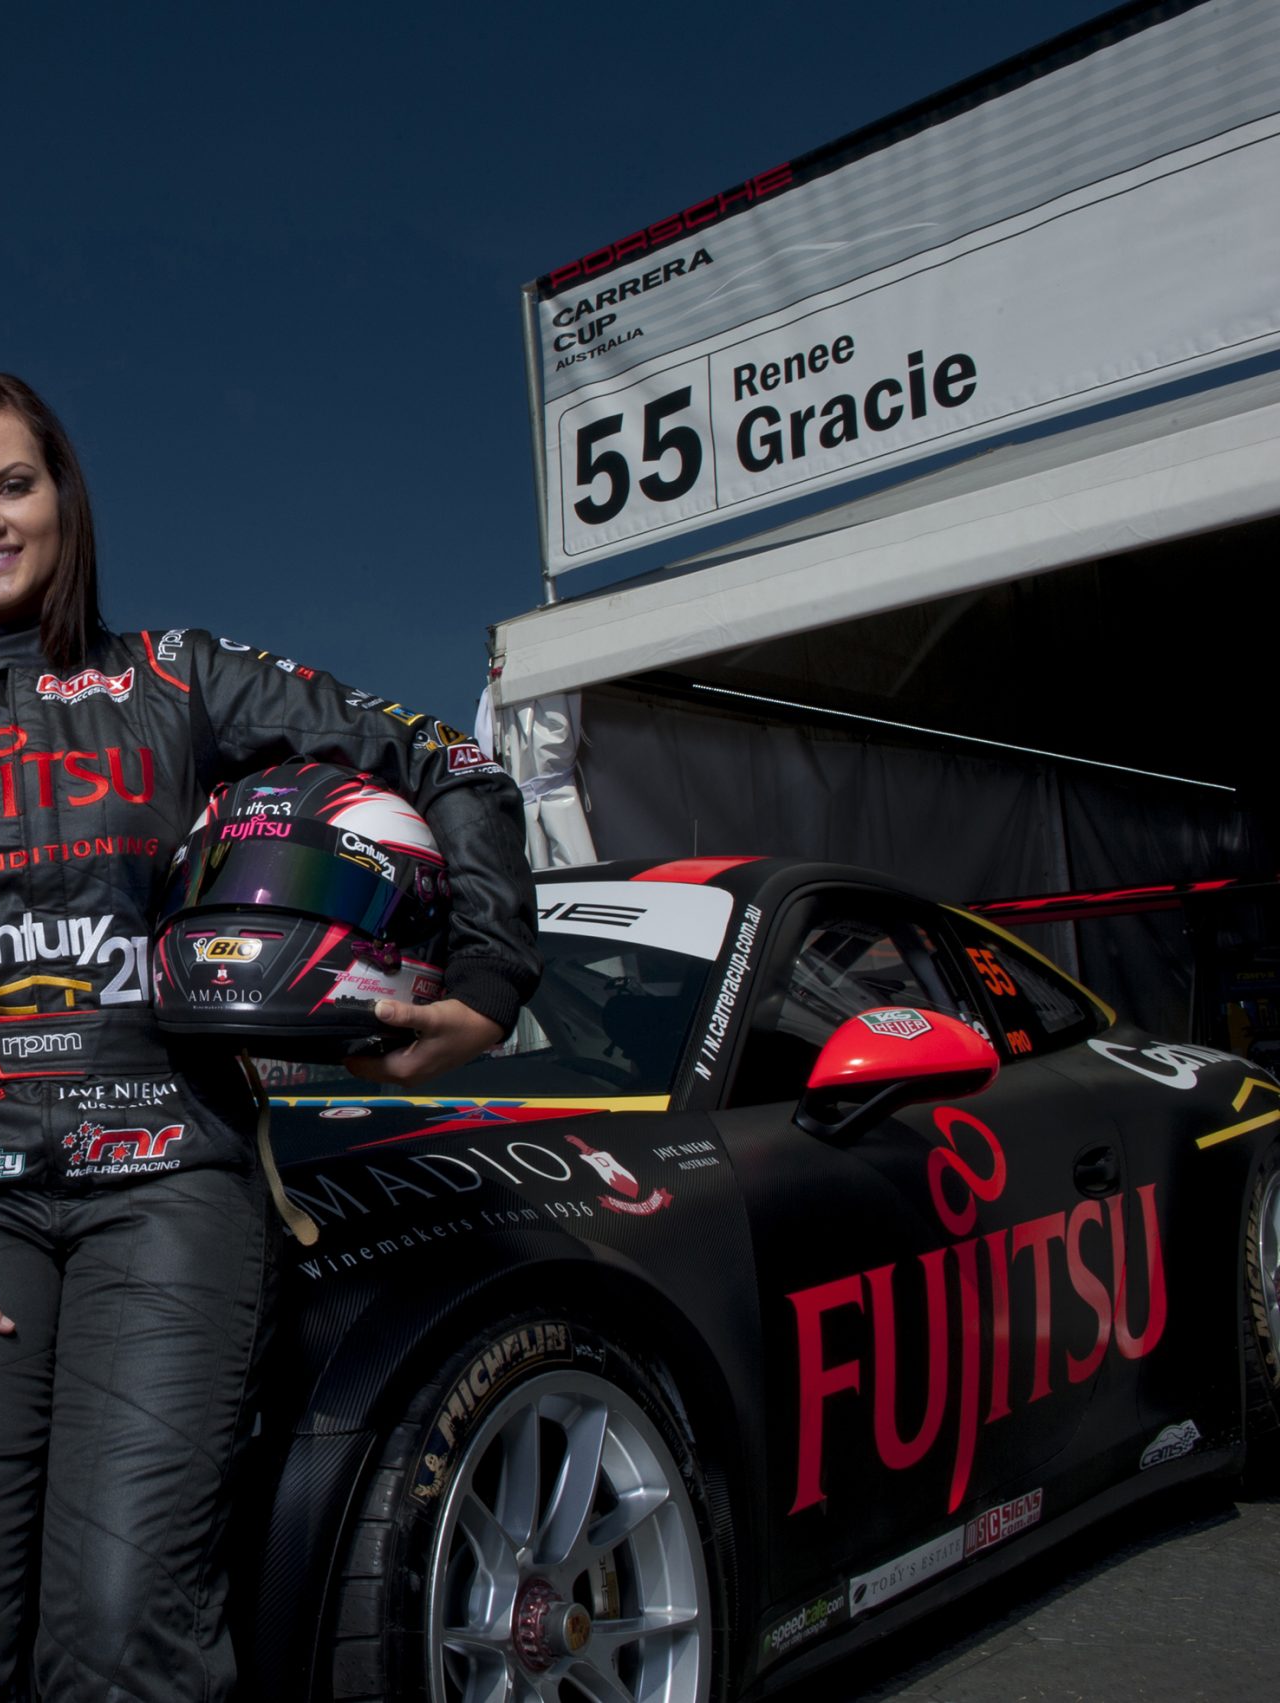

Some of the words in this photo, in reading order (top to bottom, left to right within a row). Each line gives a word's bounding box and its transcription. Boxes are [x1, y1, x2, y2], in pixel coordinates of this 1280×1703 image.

[550, 161, 794, 288] PORSCHE
[552, 247, 714, 328] CARRERA
[554, 312, 617, 352] CUP
[555, 327, 644, 372] AUSTRALIA
[734, 333, 855, 402] Renee
[736, 349, 978, 473] Gracie
[573, 386, 703, 525] 55
[220, 822, 292, 841] FUJITSU
[341, 832, 390, 864] Century
[381, 861, 396, 882] 21
[99, 935, 151, 1006] 21
[965, 946, 1018, 997] 55
[188, 988, 263, 1003] AMADIO
[874, 1010, 913, 1024] TAG
[874, 1020, 927, 1036] HEUER
[1, 1030, 83, 1059] rpm
[1006, 1029, 1033, 1055] PRO
[652, 1145, 681, 1161] JAYE
[677, 1139, 717, 1156] NIEMI
[677, 1156, 720, 1171] AUSTRALIA
[282, 1141, 573, 1229] MADIO
[297, 1214, 474, 1282] Winemakers
[485, 1204, 539, 1230] from
[545, 1198, 595, 1220] 1936
[783, 1182, 1169, 1517] FUJITSU
[1001, 1490, 1042, 1524] SIGNS
[871, 1560, 917, 1595] TOBY'S
[921, 1538, 962, 1571] ESTATE
